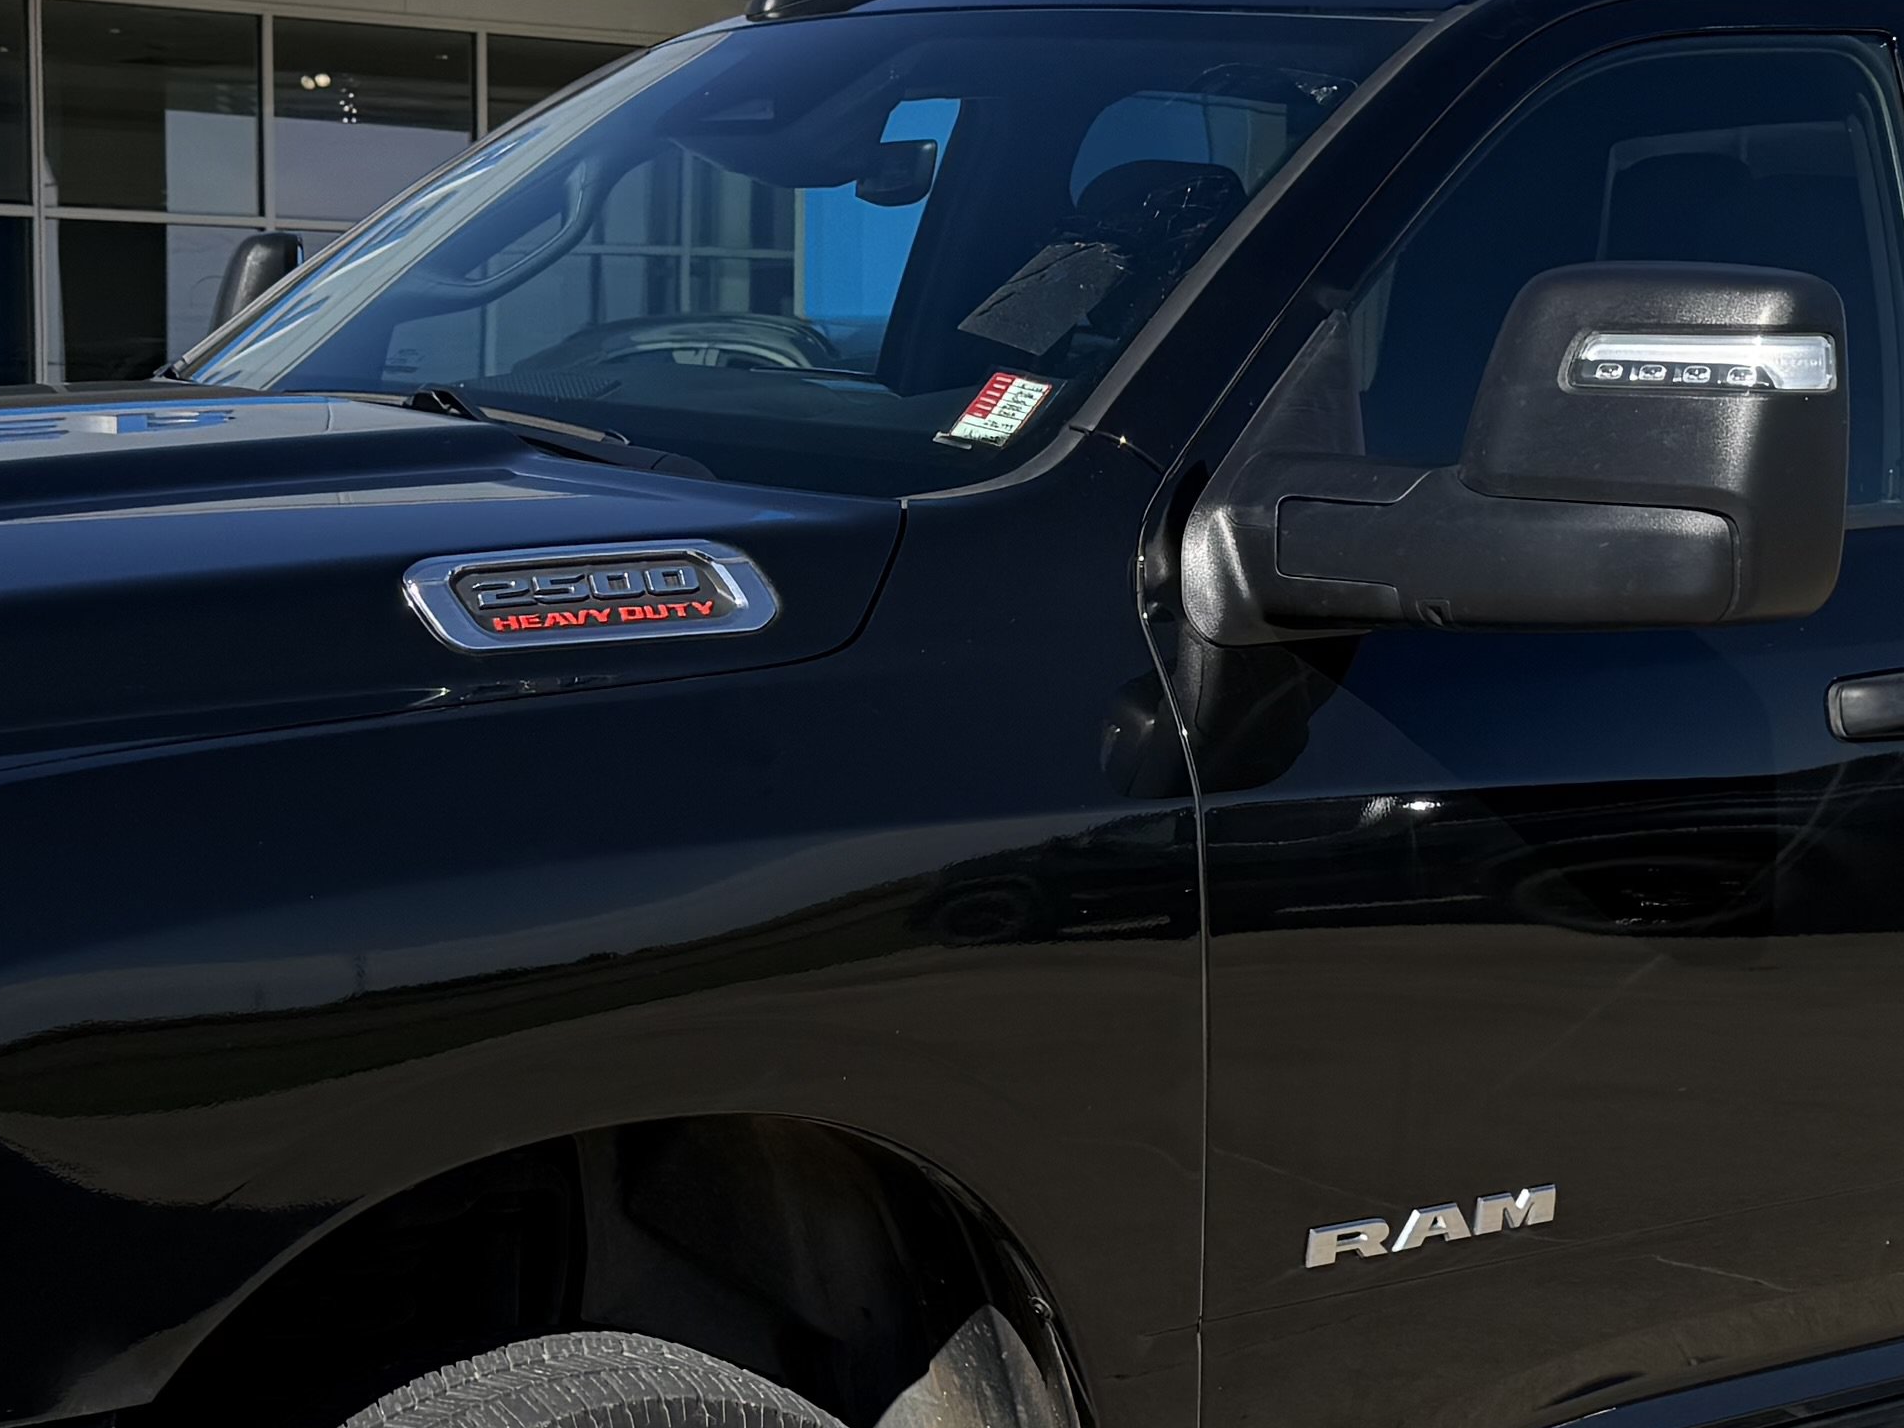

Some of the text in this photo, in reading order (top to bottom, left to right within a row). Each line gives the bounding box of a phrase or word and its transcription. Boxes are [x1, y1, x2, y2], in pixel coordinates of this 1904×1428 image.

[472, 566, 701, 611] 2500
[493, 599, 715, 633] HEAVY DUTY
[1305, 1183, 1557, 1269] RAM
